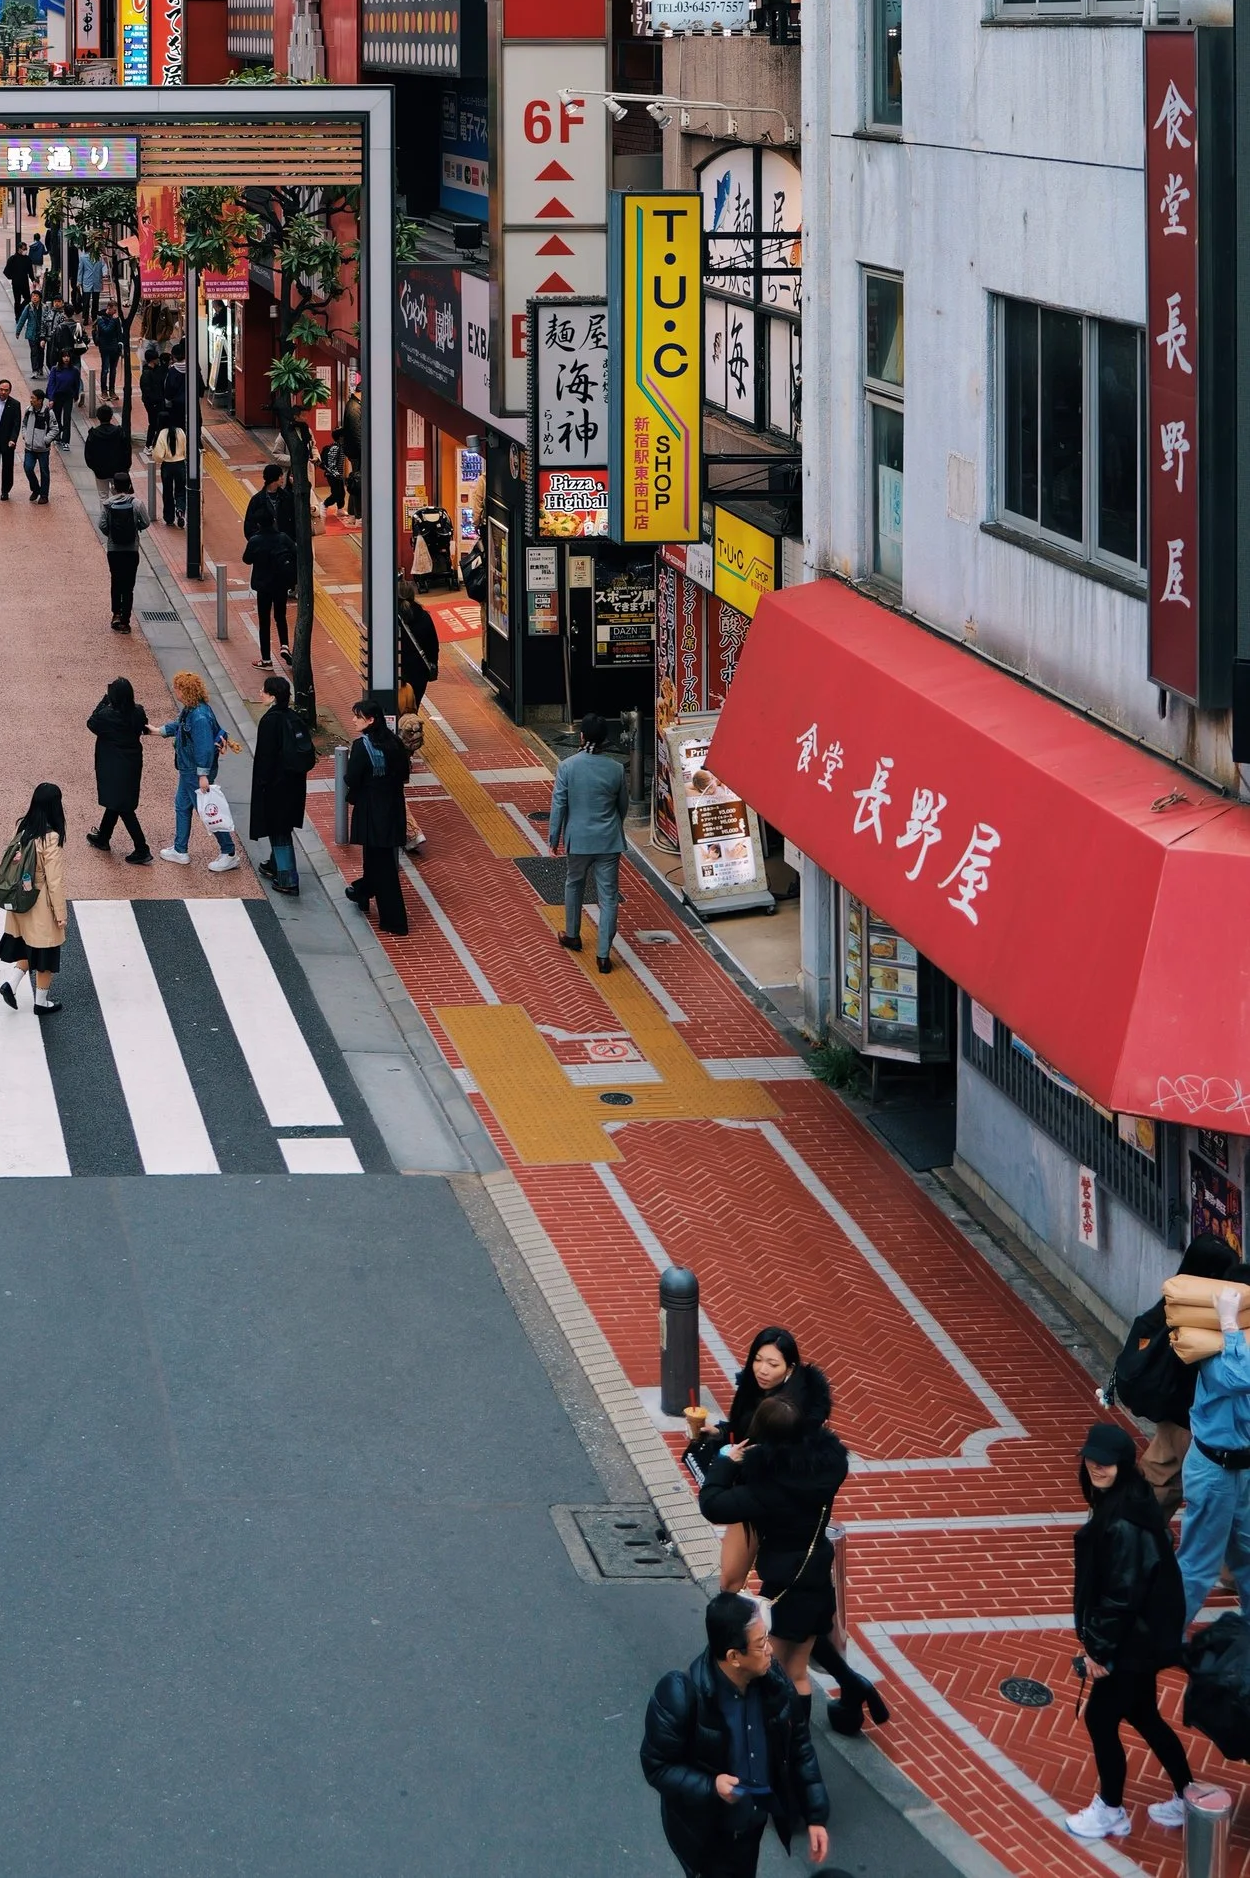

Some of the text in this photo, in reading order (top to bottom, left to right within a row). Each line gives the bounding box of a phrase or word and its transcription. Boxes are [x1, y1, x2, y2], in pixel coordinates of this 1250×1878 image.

[523, 98, 586, 145] 6F
[467, 321, 490, 362] EXB
[544, 313, 609, 353] 麺屋
[556, 358, 599, 459] 海神
[542, 409, 554, 455] らーめん
[550, 474, 604, 491] Pizza &
[633, 416, 649, 530] 新宿駅東南口店
[654, 435, 671, 511] SHOP
[543, 492, 609, 512] Highball
[755, 567, 769, 584] SHOP
[613, 627, 638, 635] DAZN
[795, 722, 1002, 926] 食堂 長野屋
